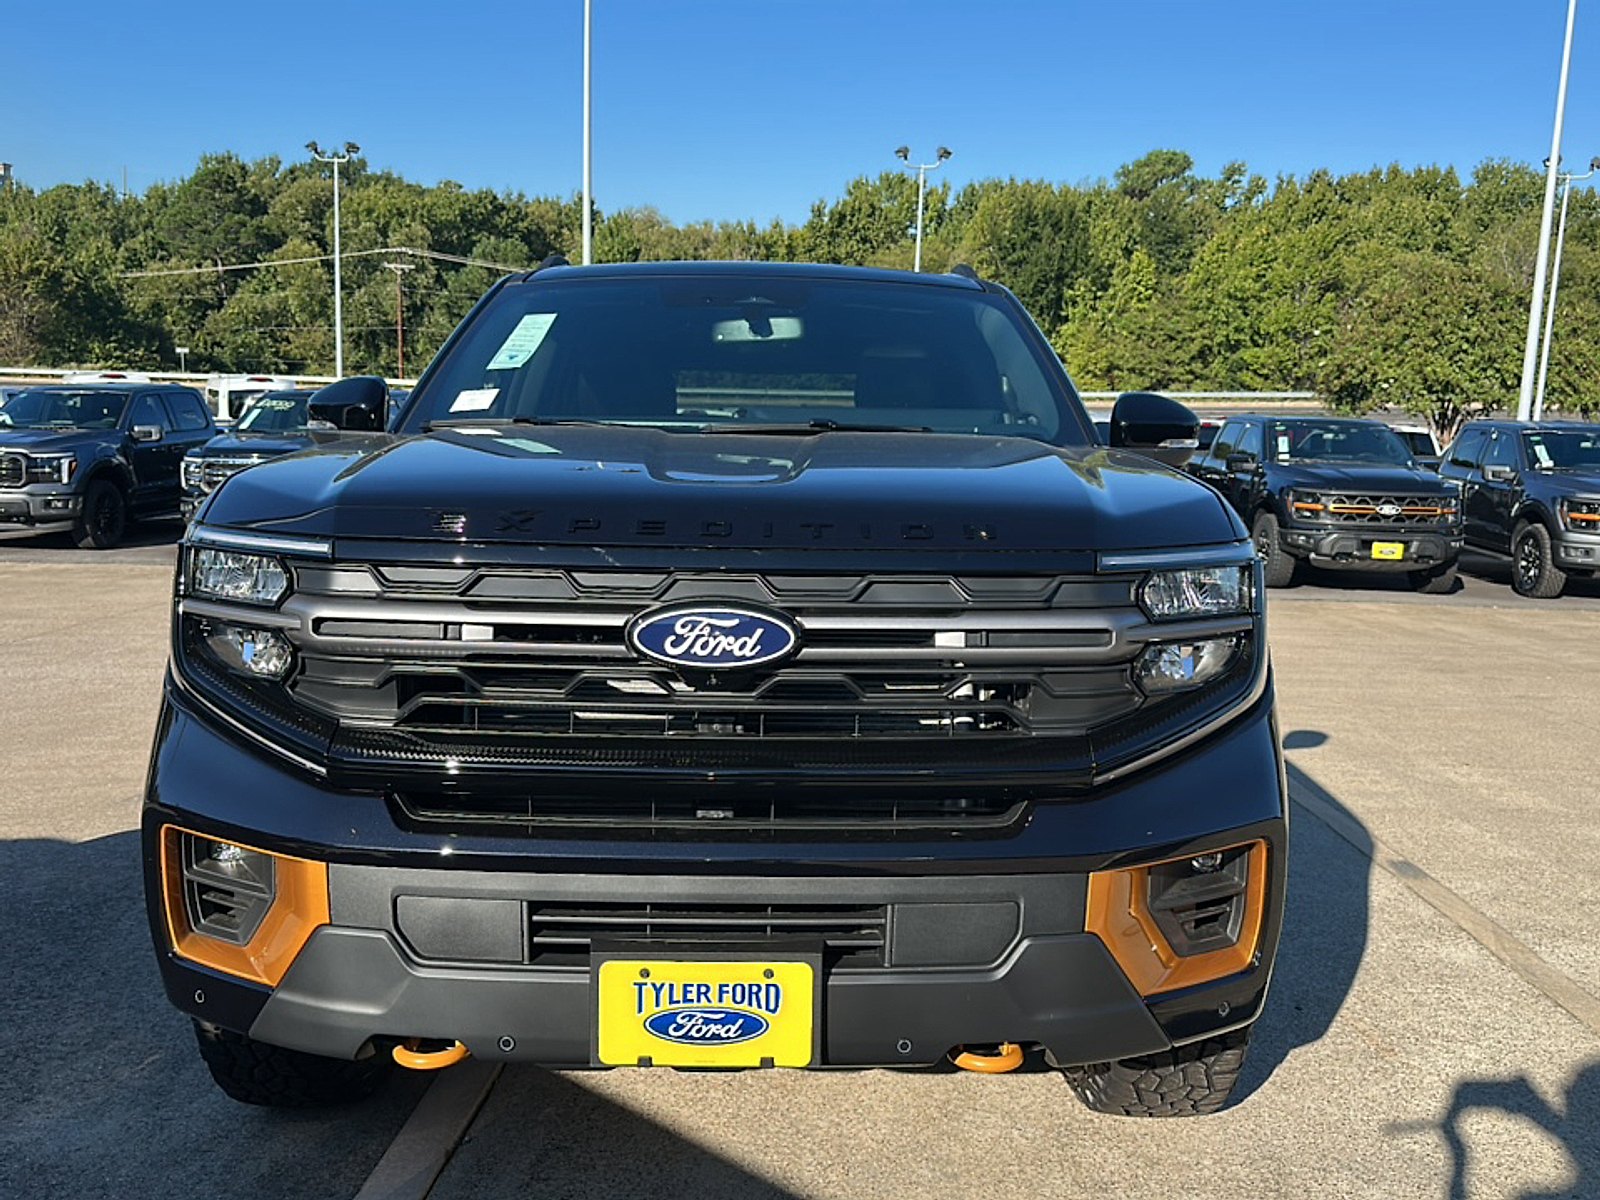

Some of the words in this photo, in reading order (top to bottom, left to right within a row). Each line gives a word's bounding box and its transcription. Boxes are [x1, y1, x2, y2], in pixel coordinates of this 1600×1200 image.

[433, 509, 998, 541] EXPEDITION
[664, 616, 764, 657] Ford
[633, 982, 712, 1014] TYLER
[717, 982, 782, 1014] FORD
[668, 1011, 744, 1038] Ford
